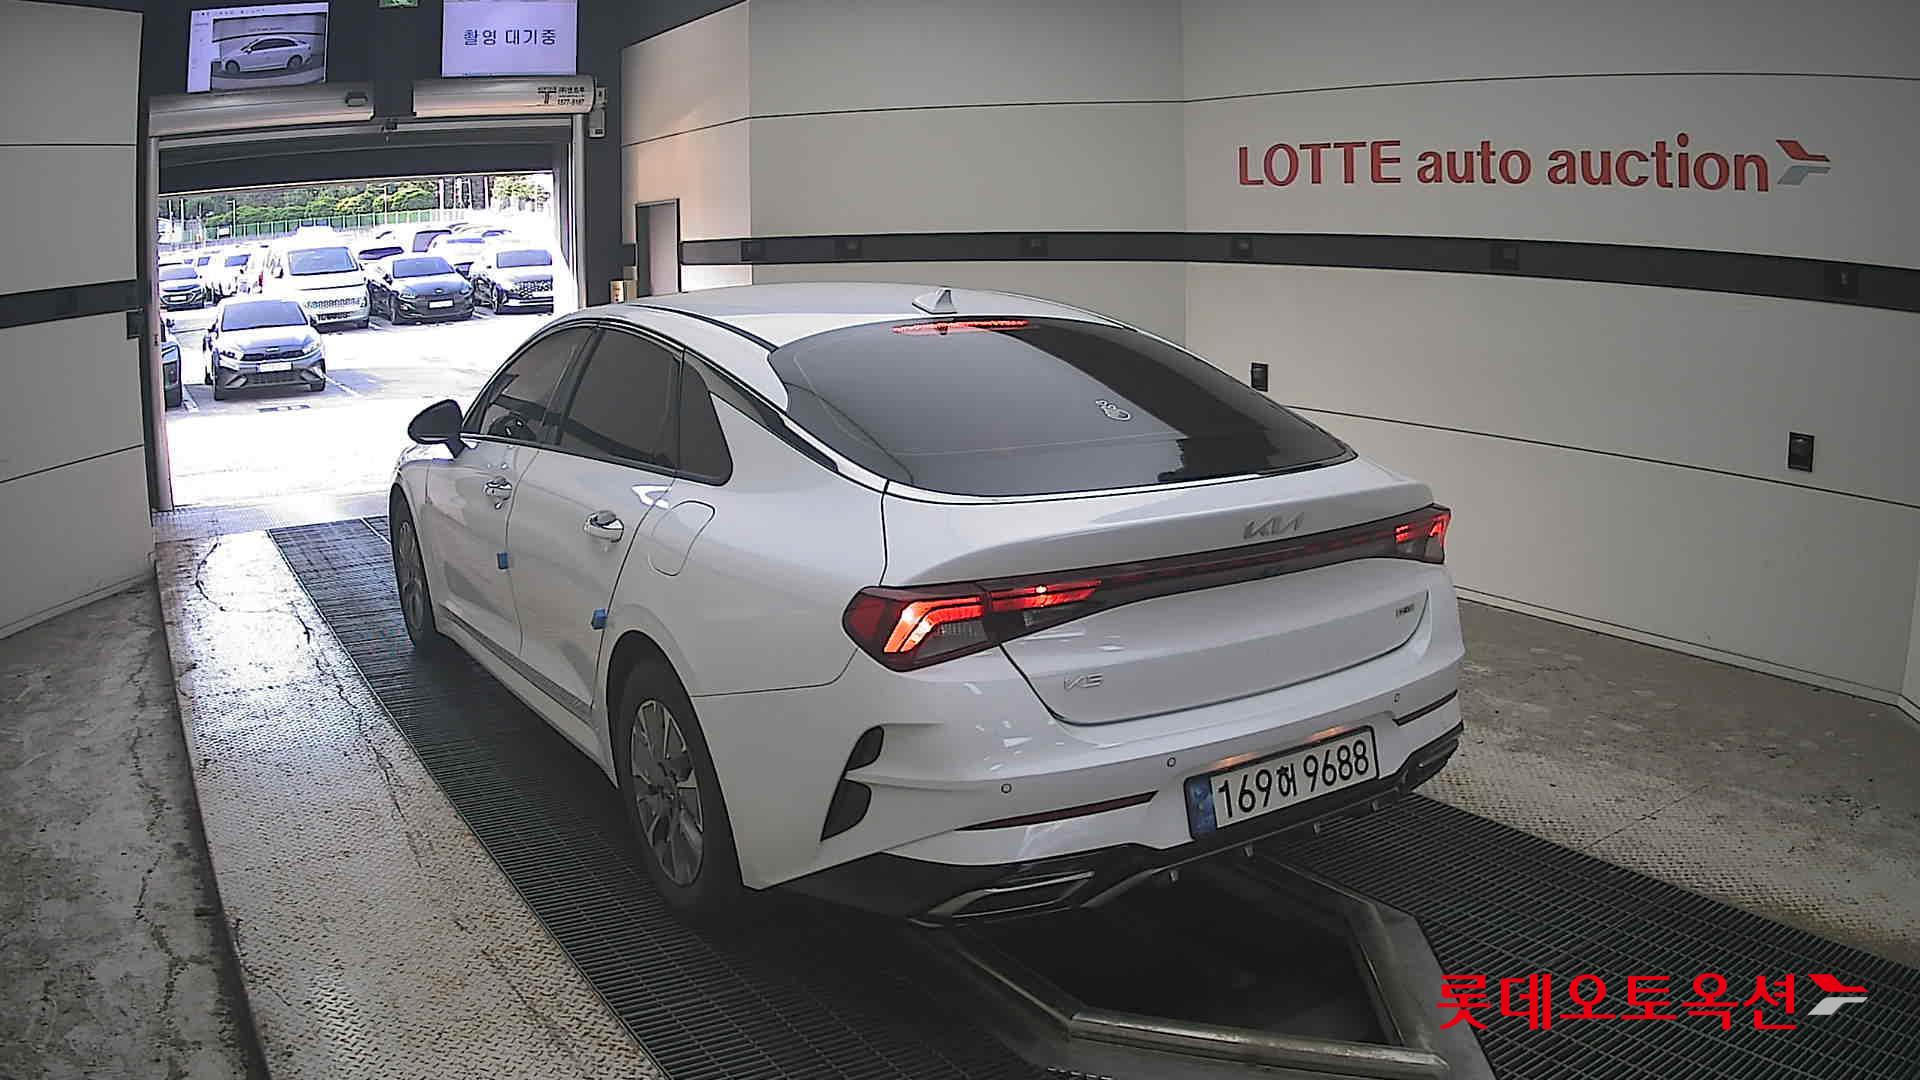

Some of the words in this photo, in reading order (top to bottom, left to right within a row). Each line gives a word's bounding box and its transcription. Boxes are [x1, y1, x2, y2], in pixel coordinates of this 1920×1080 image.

[464, 29, 497, 46] 촬영
[505, 29, 556, 45] 대기중
[1238, 140, 1401, 187] LOTTE
[1416, 139, 1532, 185] auto
[1547, 132, 1770, 193] auction
[1218, 762, 1298, 818] 169허
[1303, 739, 1369, 792] 9688
